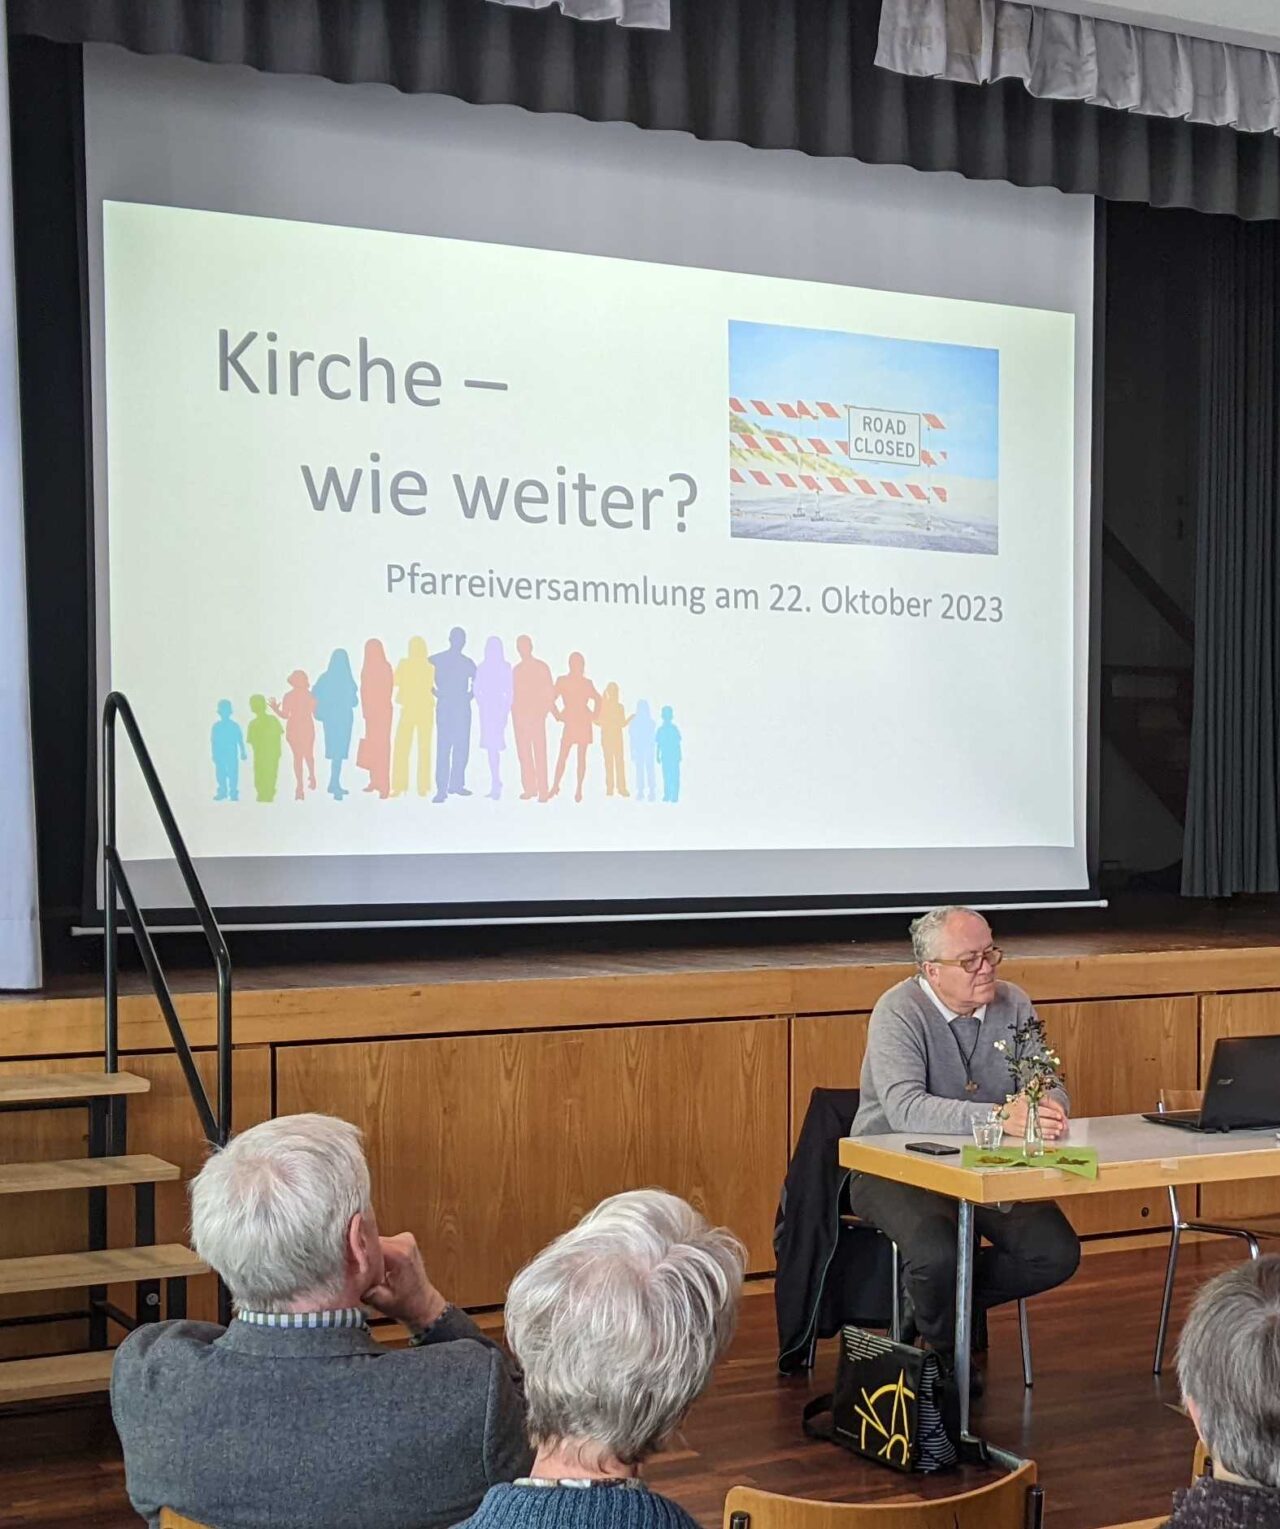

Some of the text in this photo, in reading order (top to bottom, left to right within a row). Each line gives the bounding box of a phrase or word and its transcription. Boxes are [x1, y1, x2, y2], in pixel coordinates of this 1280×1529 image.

[218, 328, 442, 407] Kirche
[853, 437, 916, 459] CLOSED
[862, 415, 907, 436] ROAD
[300, 452, 698, 533] wie weiter?
[386, 562, 1004, 623] Pfarreiversammlung am 22. Oktober 2023
